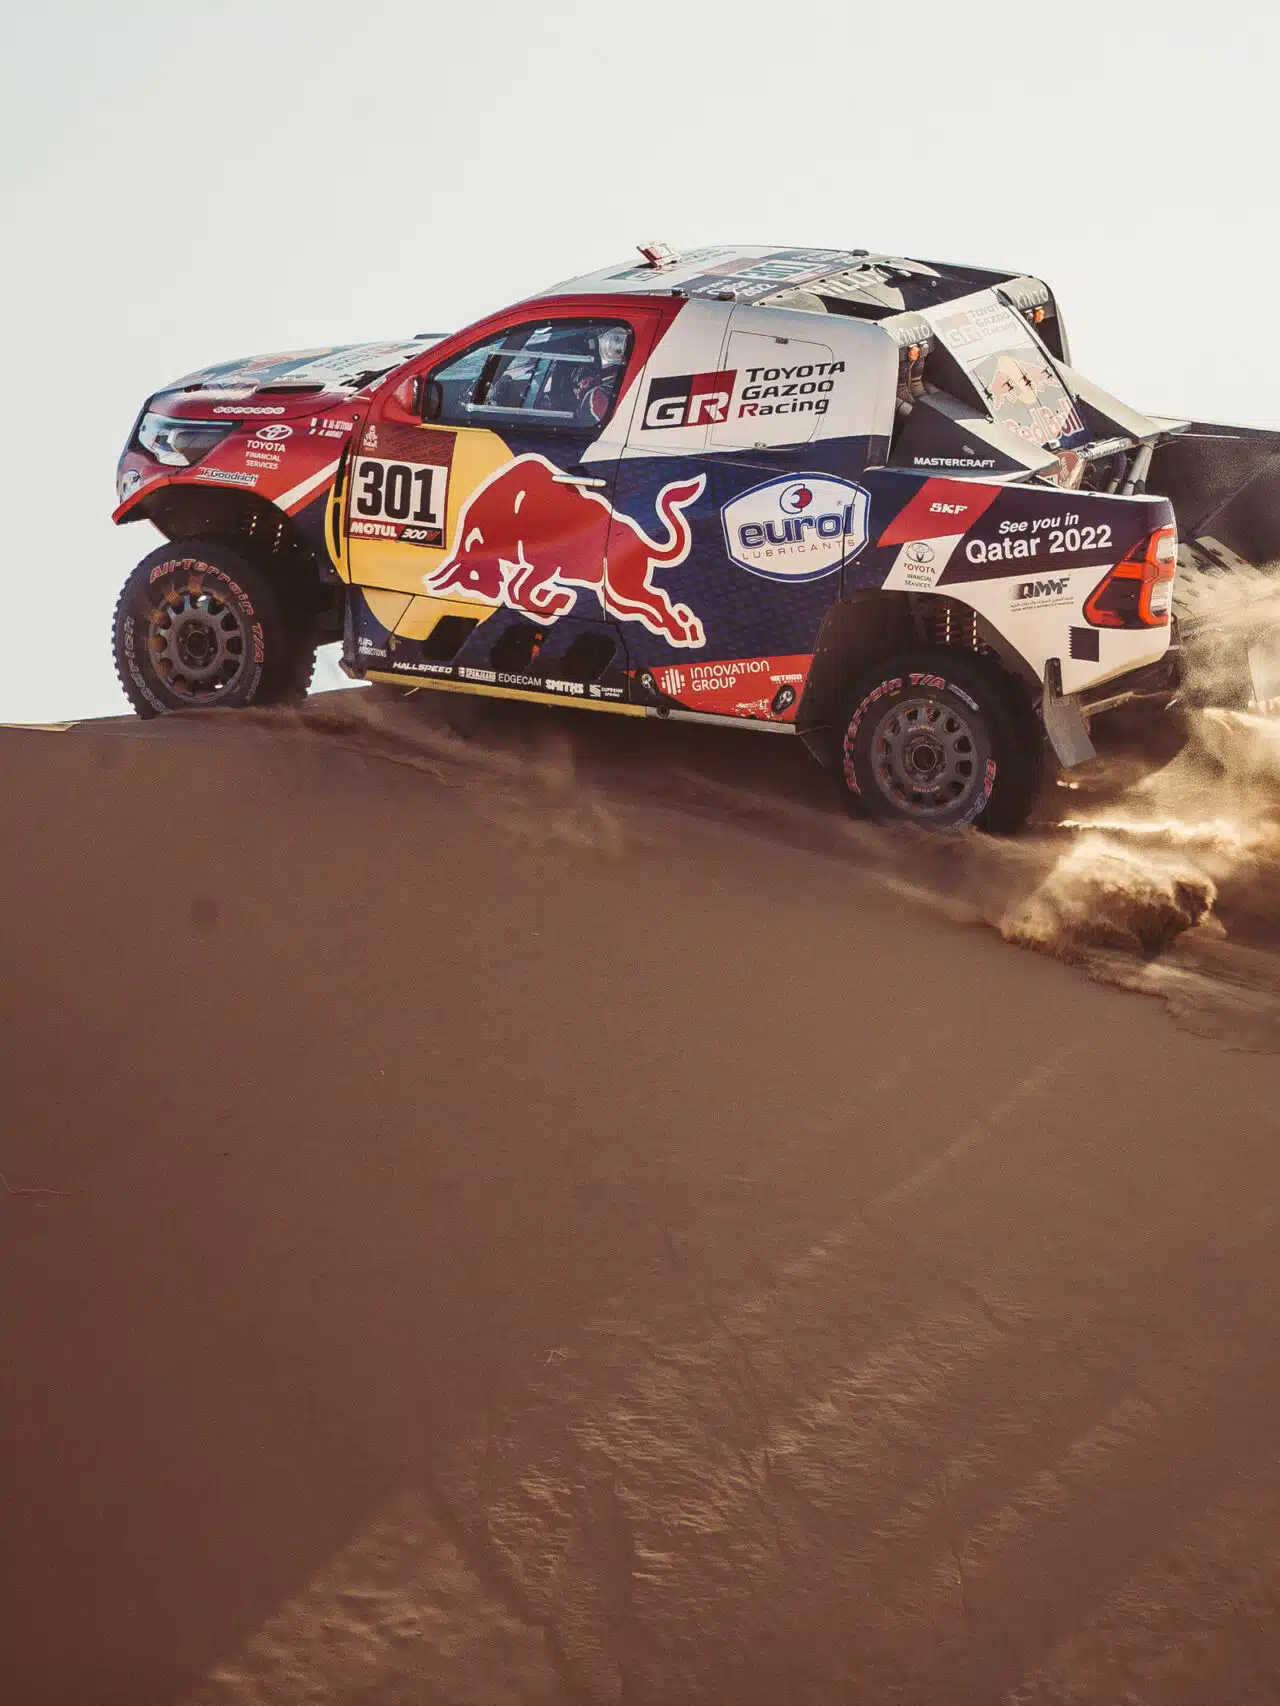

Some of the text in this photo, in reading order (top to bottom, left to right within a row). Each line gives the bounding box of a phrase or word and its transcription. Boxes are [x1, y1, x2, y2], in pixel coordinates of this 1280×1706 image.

[968, 302, 1003, 318] TOYOT
[745, 361, 846, 383] TOYOTA
[741, 379, 835, 401] GAZOO
[213, 406, 286, 416] ooredoo
[645, 391, 729, 428] GR
[737, 398, 830, 419] Racing
[247, 440, 286, 453] TOYOTA
[245, 451, 281, 463] FINANCIAL
[245, 460, 279, 471] SERVICES
[913, 456, 996, 469] MASTERCRAFT
[357, 460, 437, 524] 301
[929, 502, 968, 514] SKF
[350, 521, 441, 541] MOTUL 300V
[738, 504, 855, 549] eurol
[999, 512, 1079, 534] See you in
[742, 539, 857, 560] LUBRICANTS
[965, 523, 1112, 564] Qatar 2022
[903, 562, 936, 575] TOYOTA
[149, 558, 265, 665] All-Terrain T/A
[393, 661, 454, 674] HALLSPEED
[690, 660, 771, 680] INNOVATION
[498, 673, 543, 687] EDGECAM
[545, 679, 584, 695] SMITHS
[691, 677, 738, 692] GROUP
[909, 672, 946, 690] T/A
